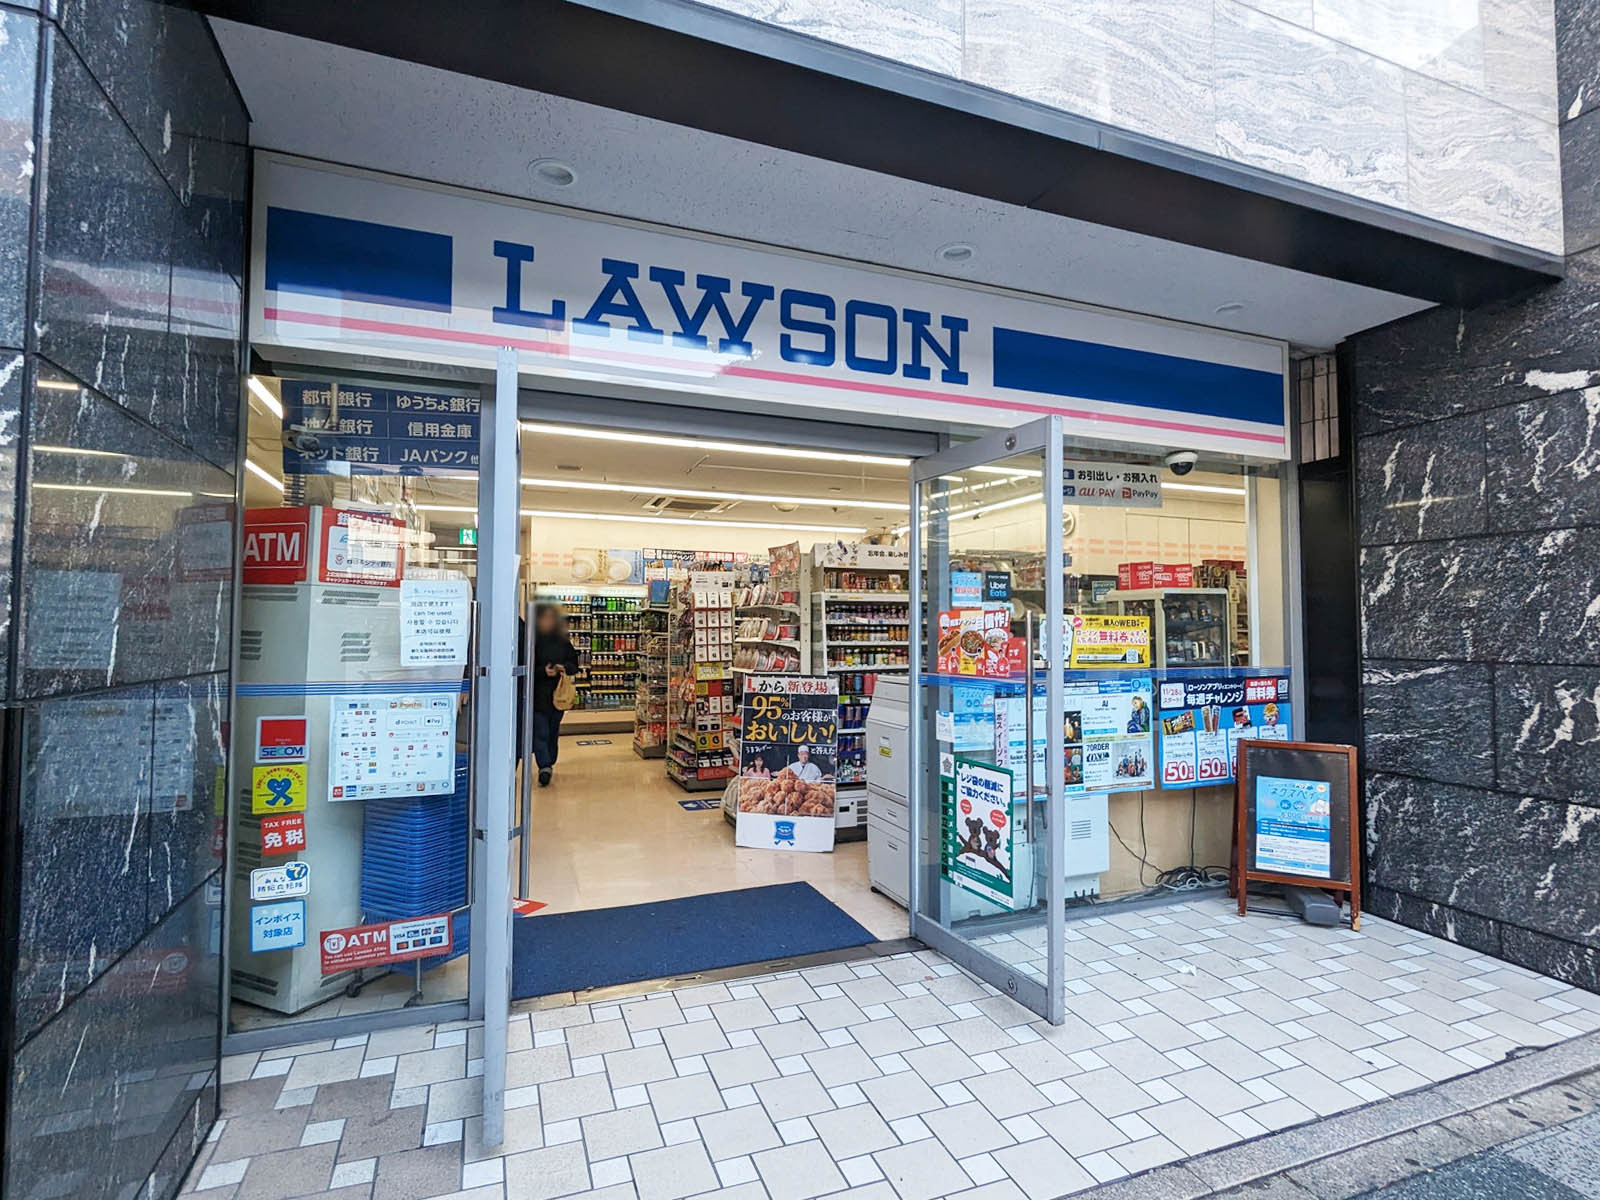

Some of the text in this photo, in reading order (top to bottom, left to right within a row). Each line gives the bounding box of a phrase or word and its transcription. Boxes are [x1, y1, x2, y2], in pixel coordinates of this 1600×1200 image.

[492, 239, 969, 386] LAWSON
[302, 389, 372, 408] 都市銀行
[396, 395, 481, 413] ゆうちょ銀行
[407, 421, 472, 438] 信用金庫
[300, 446, 379, 462] ネット銀行
[400, 448, 468, 463] JAバンク
[1077, 469, 1158, 484] お引出し・お預入れ
[1079, 487, 1115, 497] au PAY
[1132, 489, 1158, 499] PayPay
[243, 532, 300, 562] ATM
[989, 581, 1006, 589] Uber
[989, 589, 1006, 597] Eats
[1186, 691, 1244, 706] 毎週チャレンジ
[745, 720, 835, 744] おいしい!
[262, 746, 303, 757] SECOM
[1166, 761, 1189, 781] 50
[1200, 758, 1221, 778] 50
[281, 818, 302, 826] FREE
[264, 828, 304, 848] 免税
[255, 912, 301, 926] インボイス
[263, 927, 293, 939] 対象店
[347, 929, 387, 948] ATM
